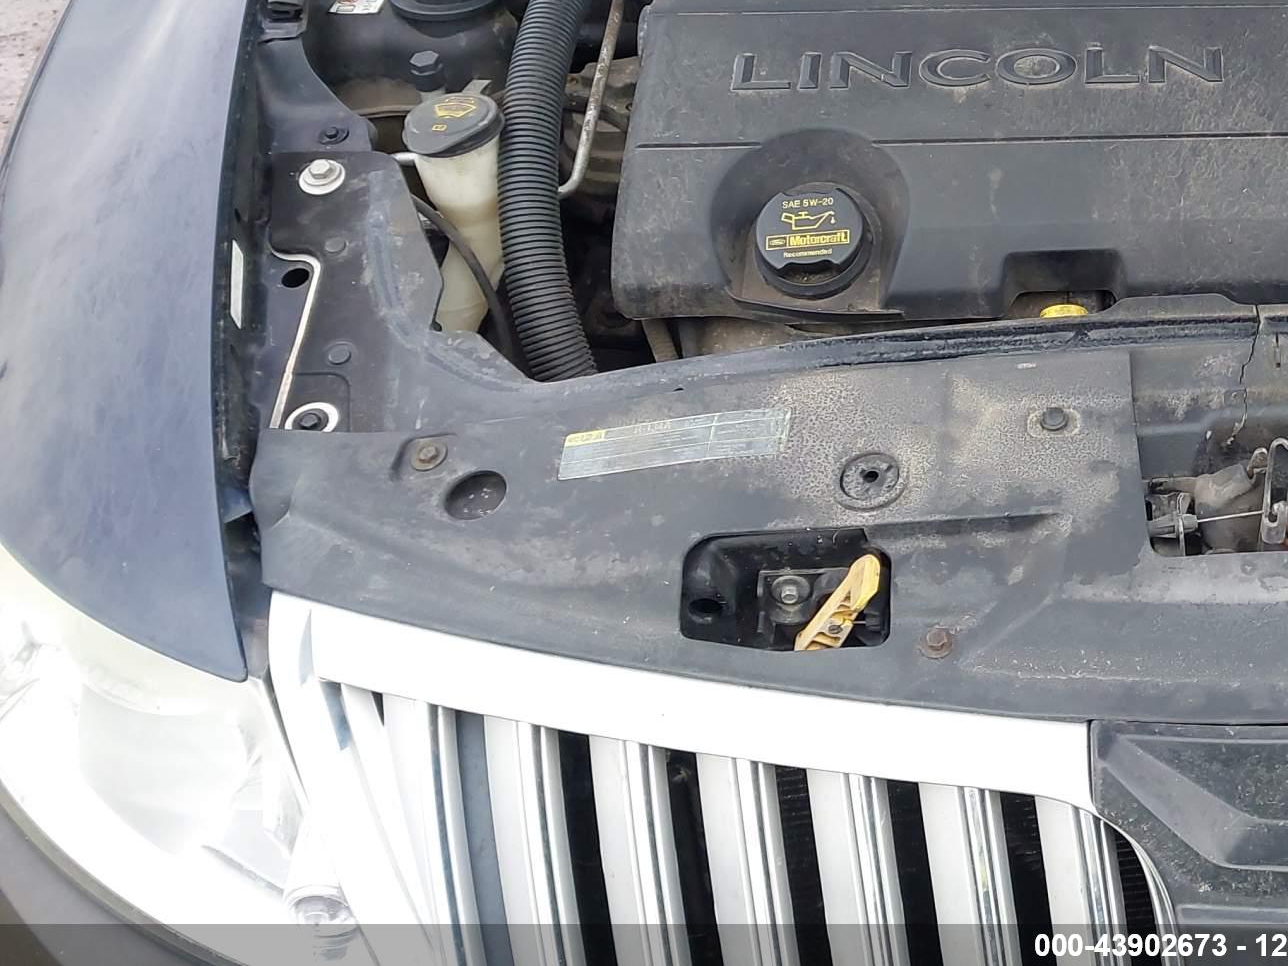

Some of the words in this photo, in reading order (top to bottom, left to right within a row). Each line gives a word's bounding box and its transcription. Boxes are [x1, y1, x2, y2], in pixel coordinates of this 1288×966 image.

[731, 43, 1224, 90] LINCOLN
[782, 200, 801, 209] SAE
[803, 197, 834, 208] 5W-20
[789, 232, 847, 246] Motorcraft
[783, 248, 833, 258] Recommended
